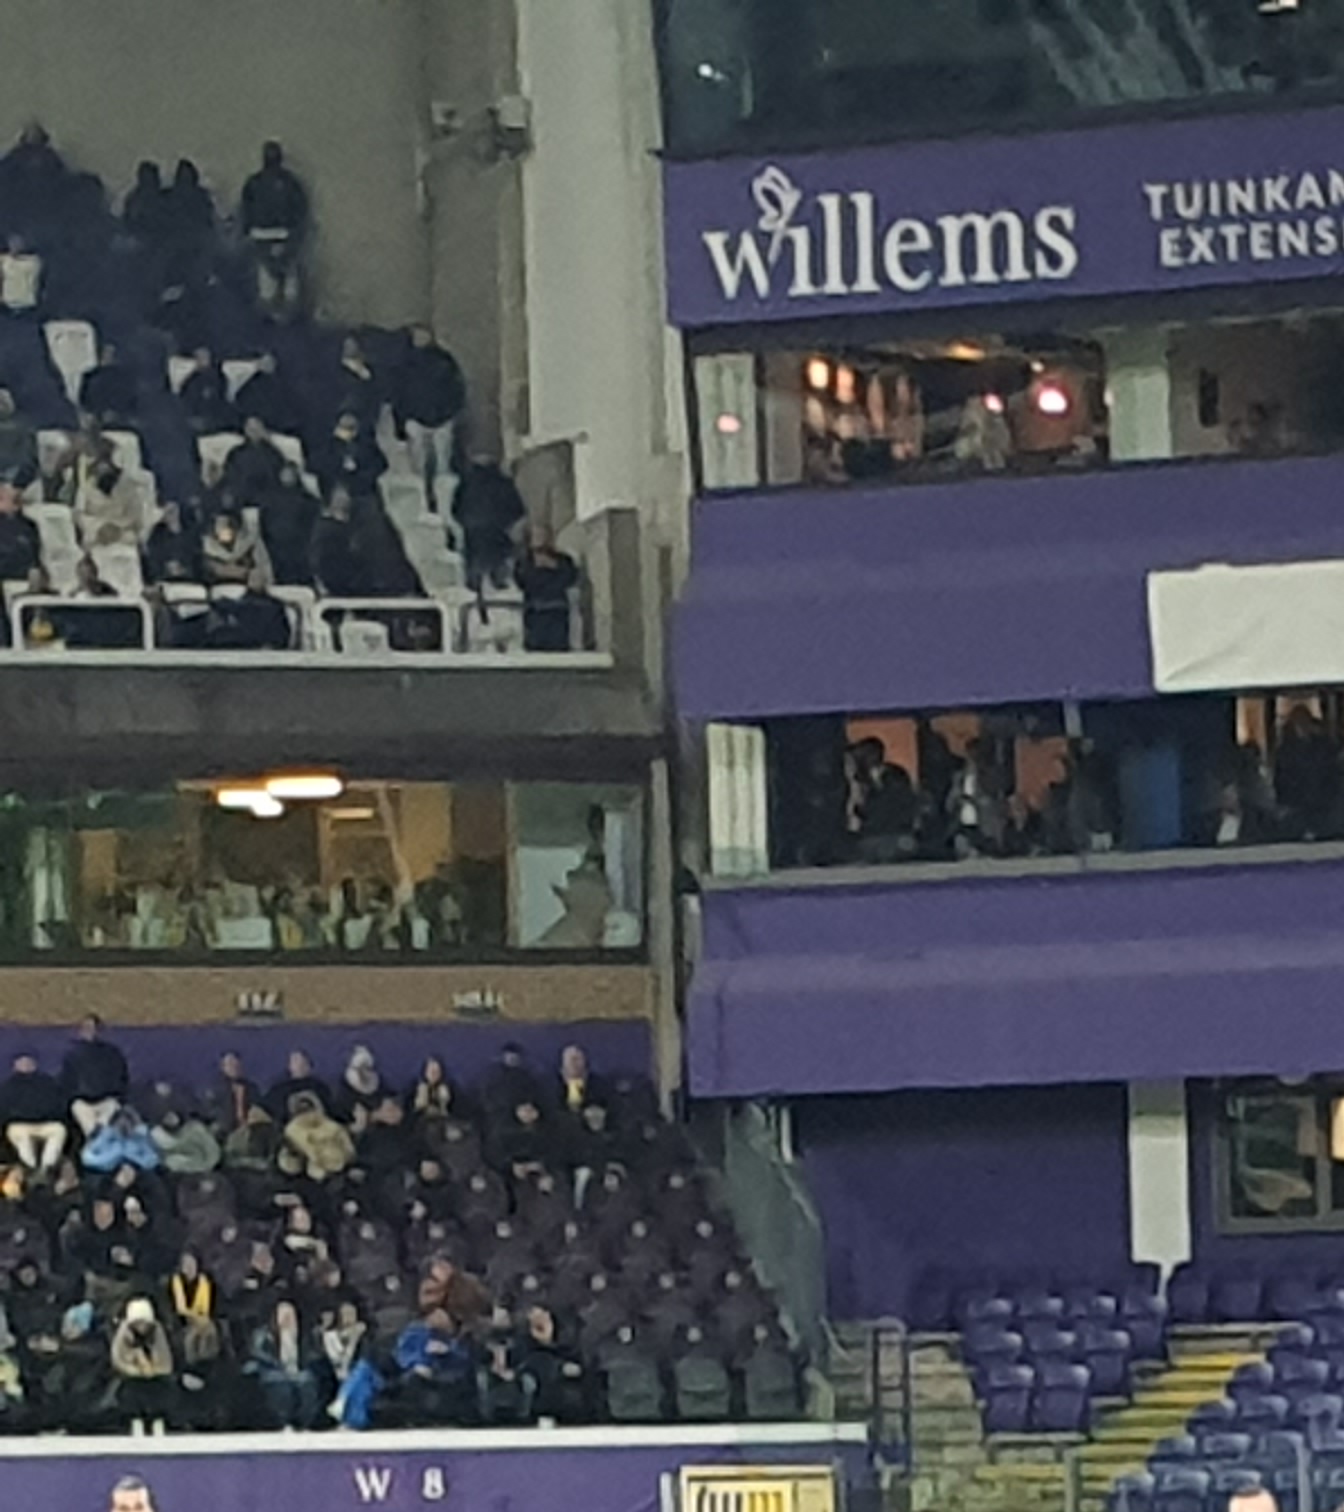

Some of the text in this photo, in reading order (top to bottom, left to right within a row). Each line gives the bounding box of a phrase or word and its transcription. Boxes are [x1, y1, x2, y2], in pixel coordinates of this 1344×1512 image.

[703, 165, 1079, 300] willems
[355, 1466, 445, 1502] W 8
